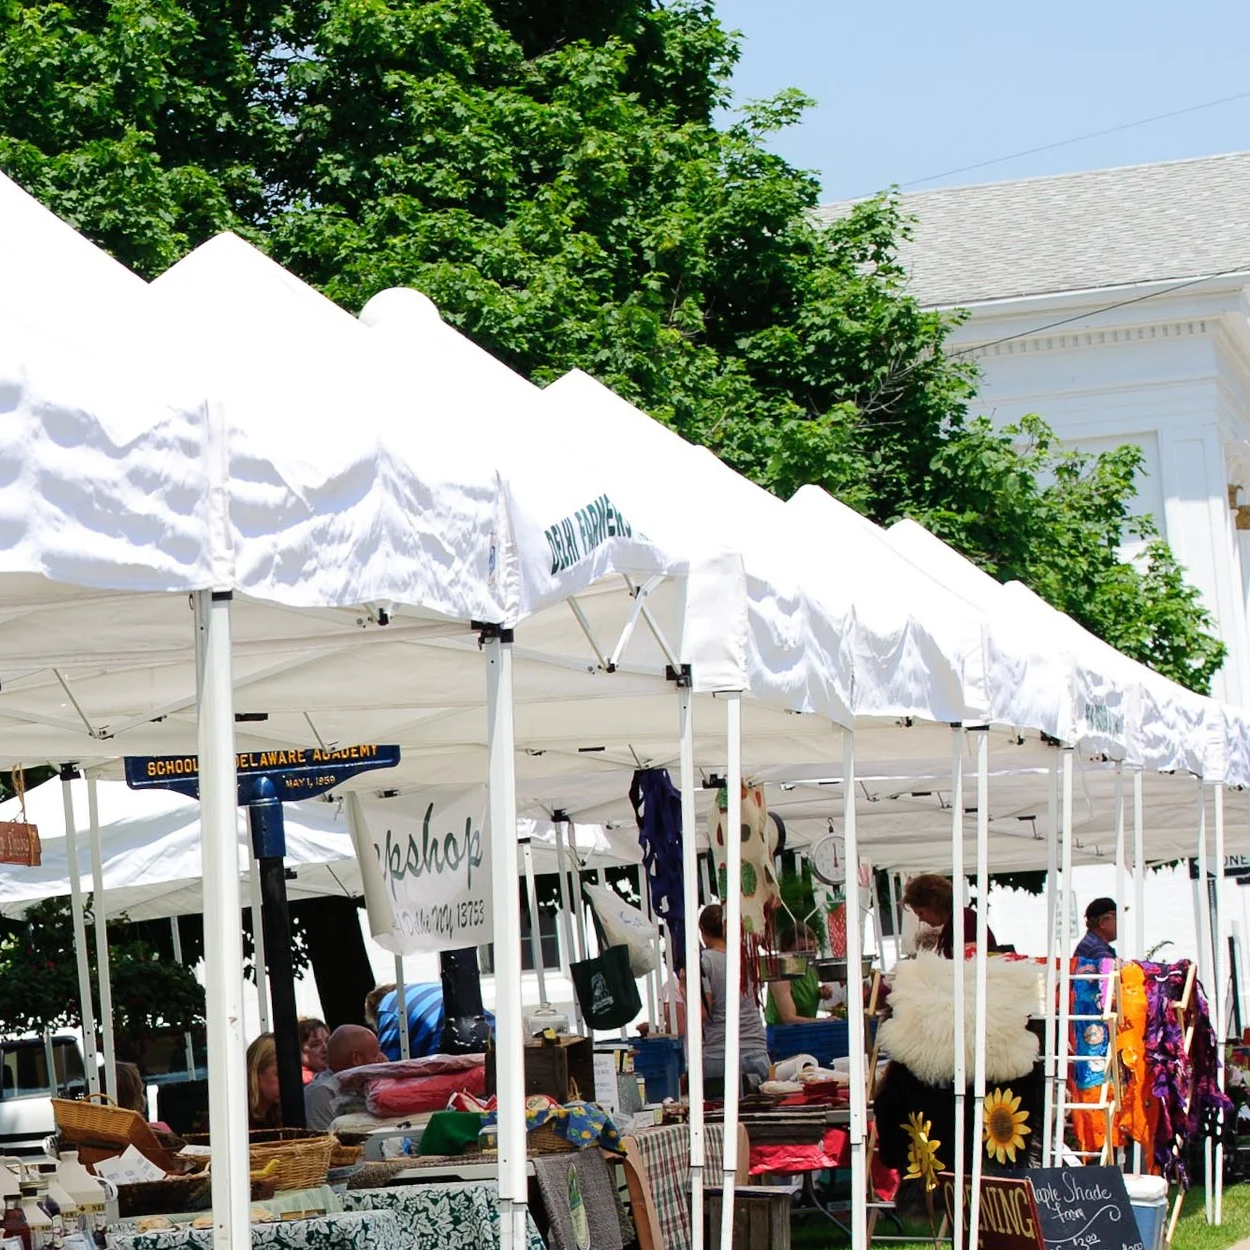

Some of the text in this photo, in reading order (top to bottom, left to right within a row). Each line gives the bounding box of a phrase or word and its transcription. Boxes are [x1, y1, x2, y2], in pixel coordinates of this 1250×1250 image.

[545, 516, 581, 575] DELHI
[147, 758, 199, 776] SCHOOL
[313, 744, 378, 761] ACADEMY
[456, 899, 484, 928] 13753
[1062, 1171, 1112, 1203] Shade
